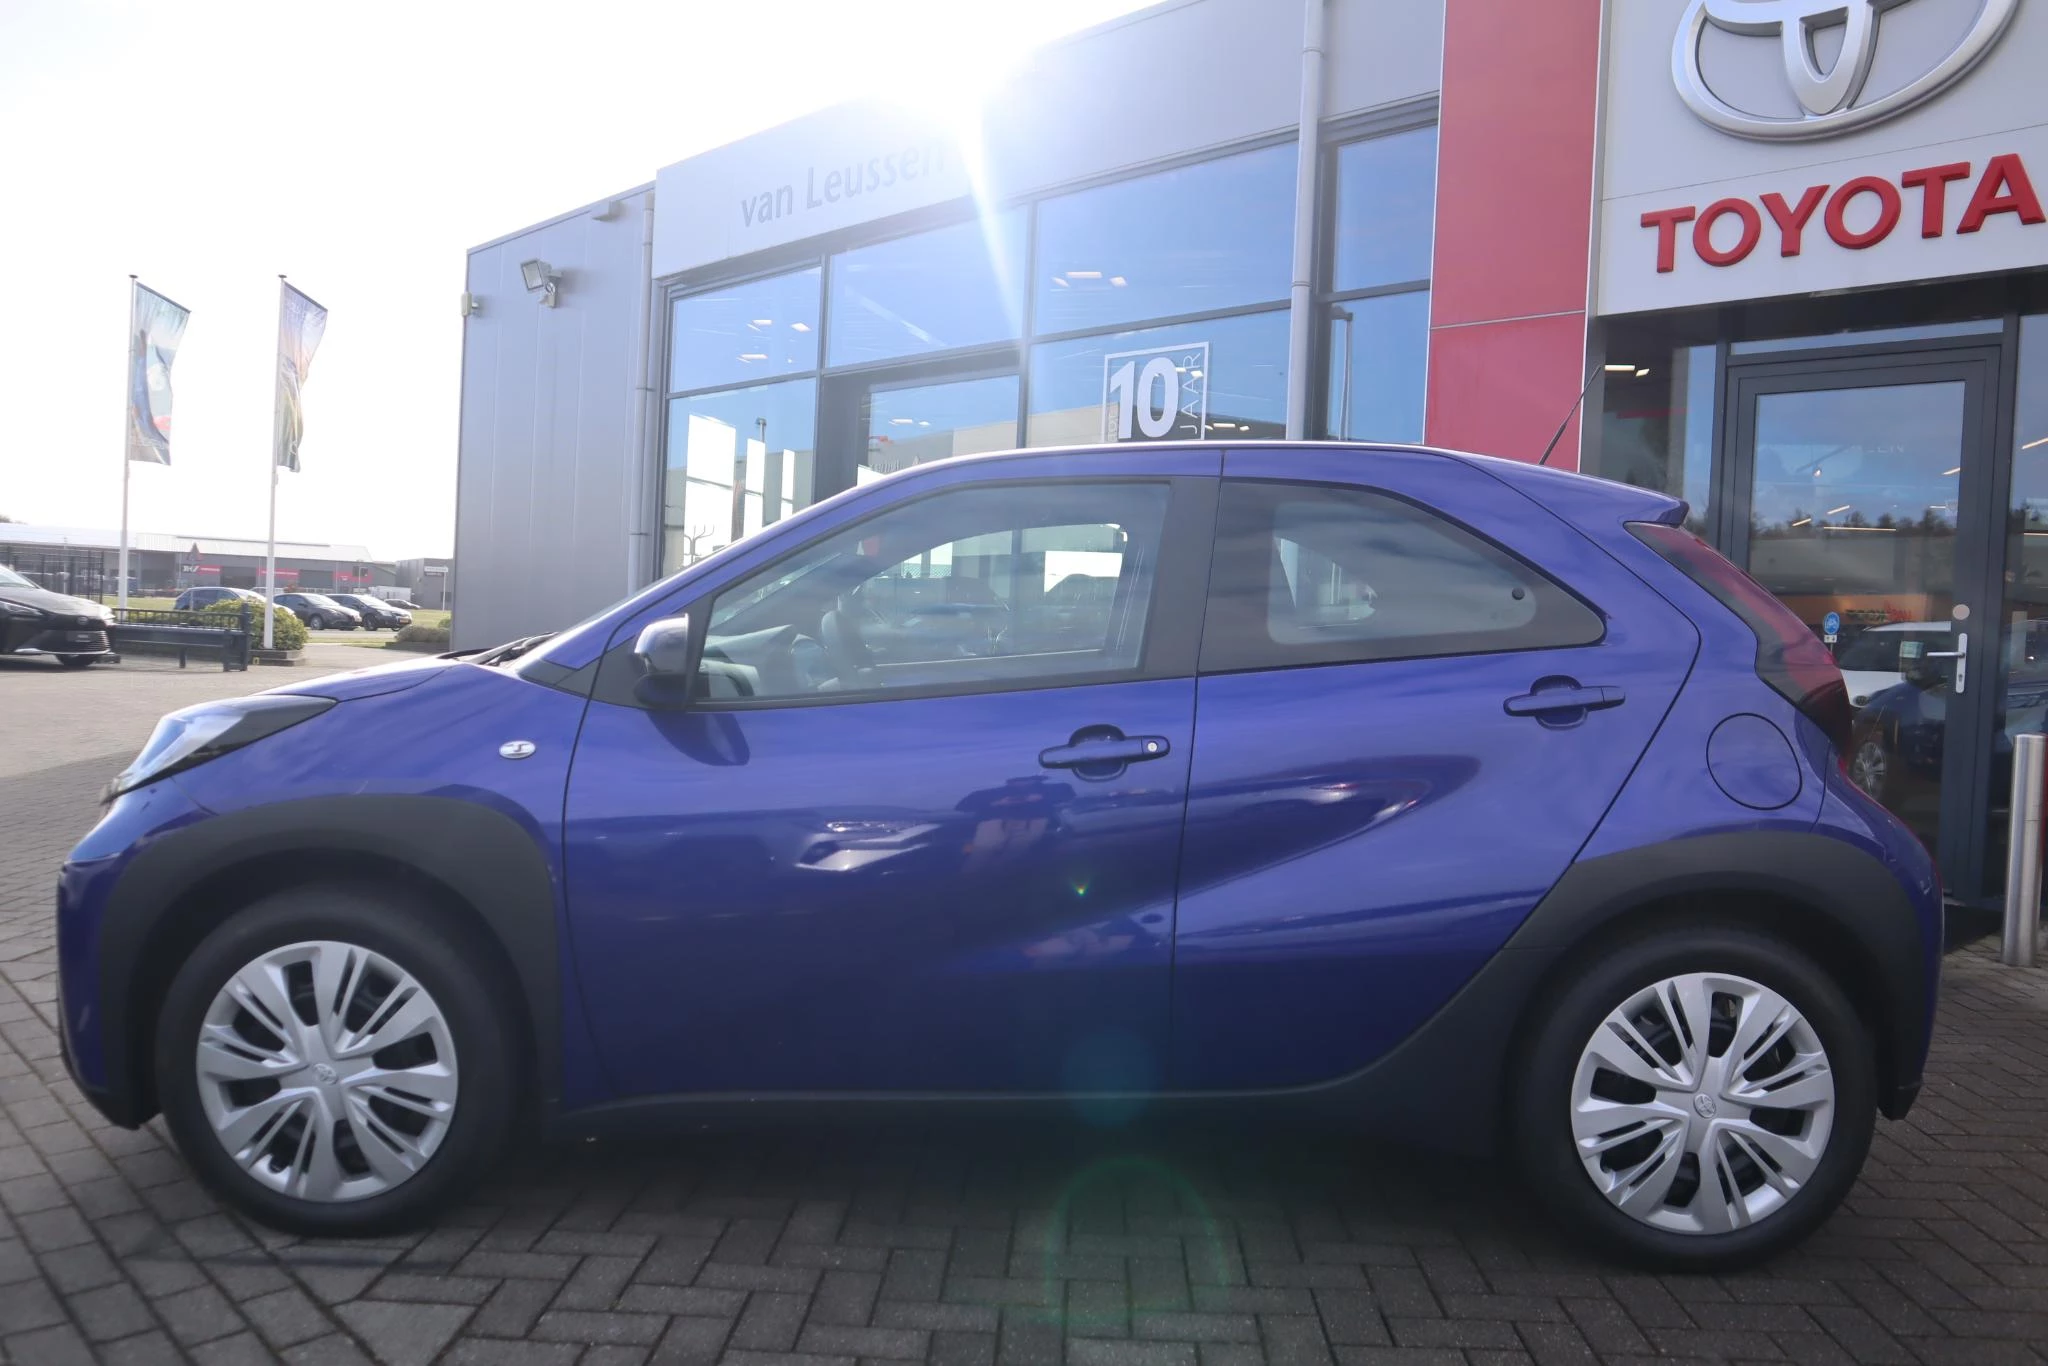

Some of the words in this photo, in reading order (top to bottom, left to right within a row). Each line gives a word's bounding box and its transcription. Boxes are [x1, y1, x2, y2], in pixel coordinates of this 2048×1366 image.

[740, 185, 793, 228] van
[806, 146, 945, 209] Leussen
[1640, 153, 2046, 273] TOYOTA
[1109, 357, 1179, 438] 10
[1180, 352, 1201, 434] JAAR
